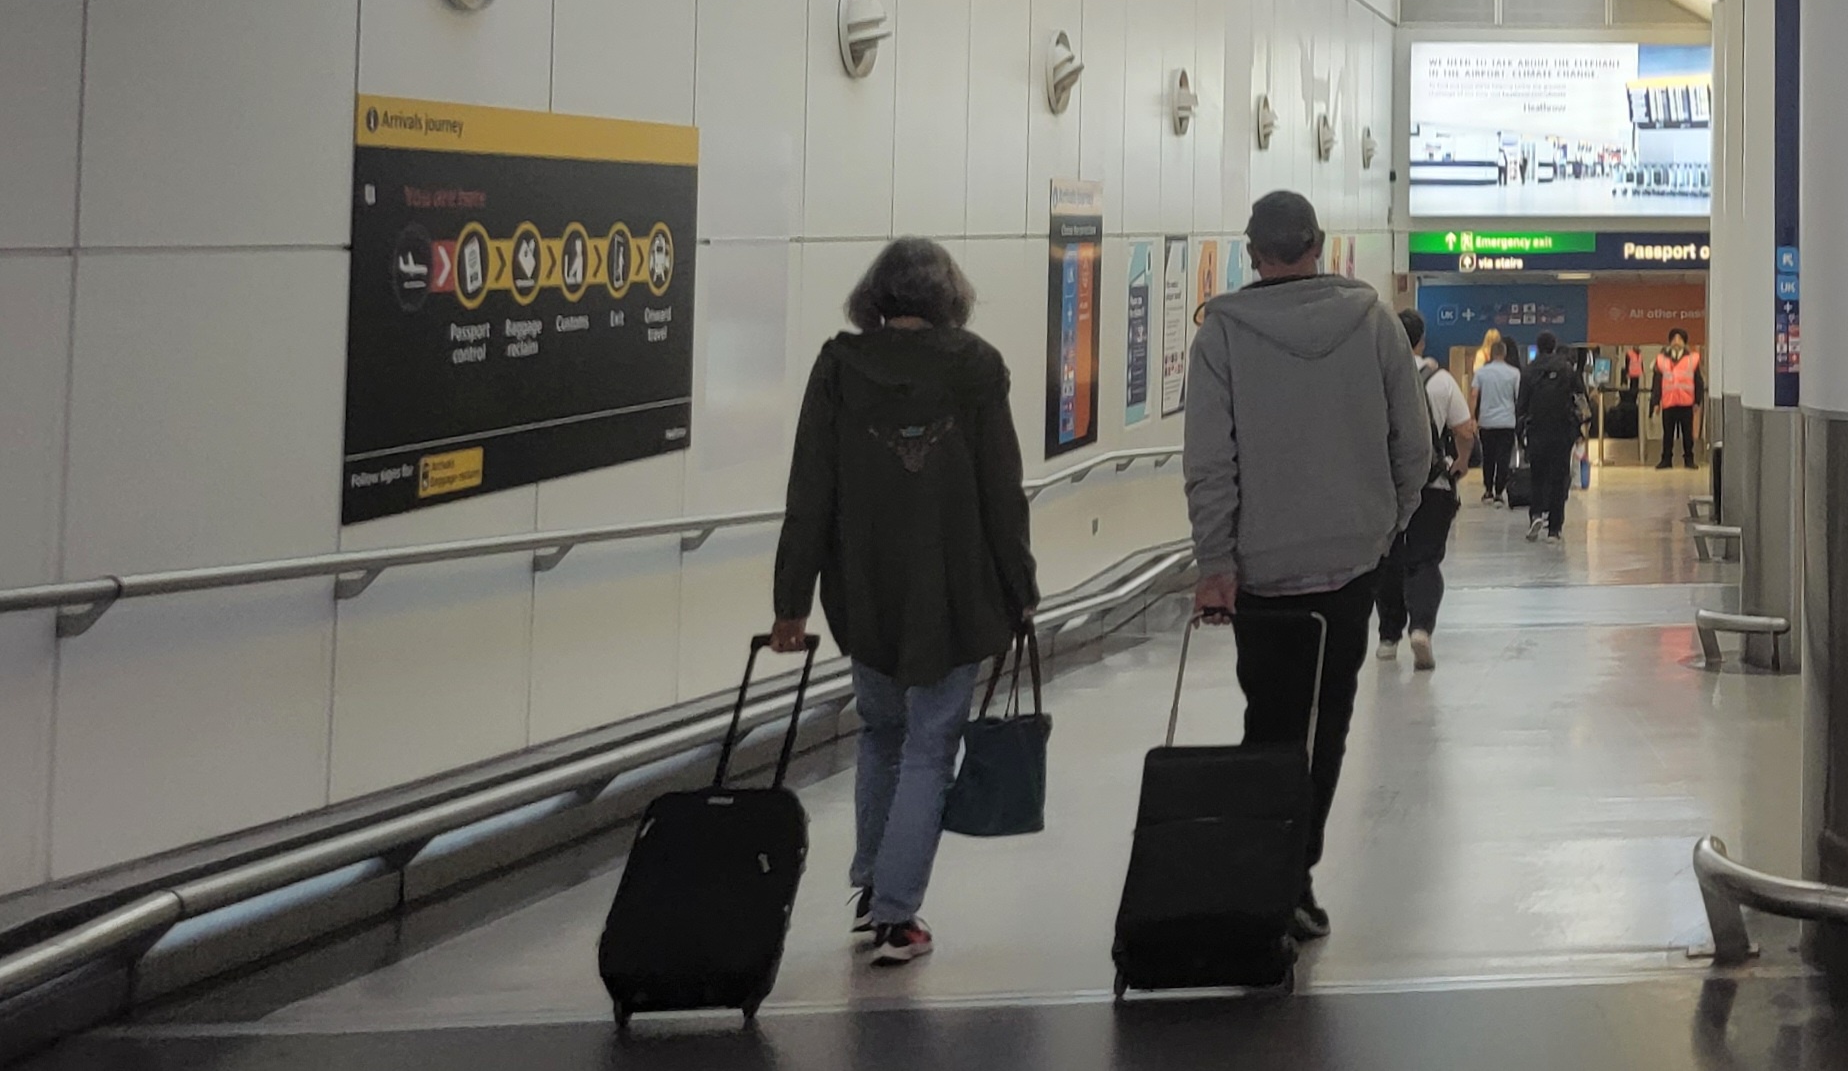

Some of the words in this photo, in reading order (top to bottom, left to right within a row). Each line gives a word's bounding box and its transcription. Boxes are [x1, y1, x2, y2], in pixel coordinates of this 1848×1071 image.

[381, 110, 423, 130] Arrivals
[424, 113, 464, 138] journey
[1475, 236, 1531, 250] Emergency
[1533, 236, 1553, 249] exit
[1624, 242, 1697, 262] Passport
[1478, 258, 1494, 270] via
[1495, 257, 1524, 270] stairs
[1781, 283, 1796, 294] UK
[1441, 310, 1454, 321] UK
[1629, 309, 1644, 319] All
[1647, 309, 1677, 319] other
[556, 314, 590, 332] Customs
[451, 322, 491, 342] Passport
[452, 343, 487, 364] control
